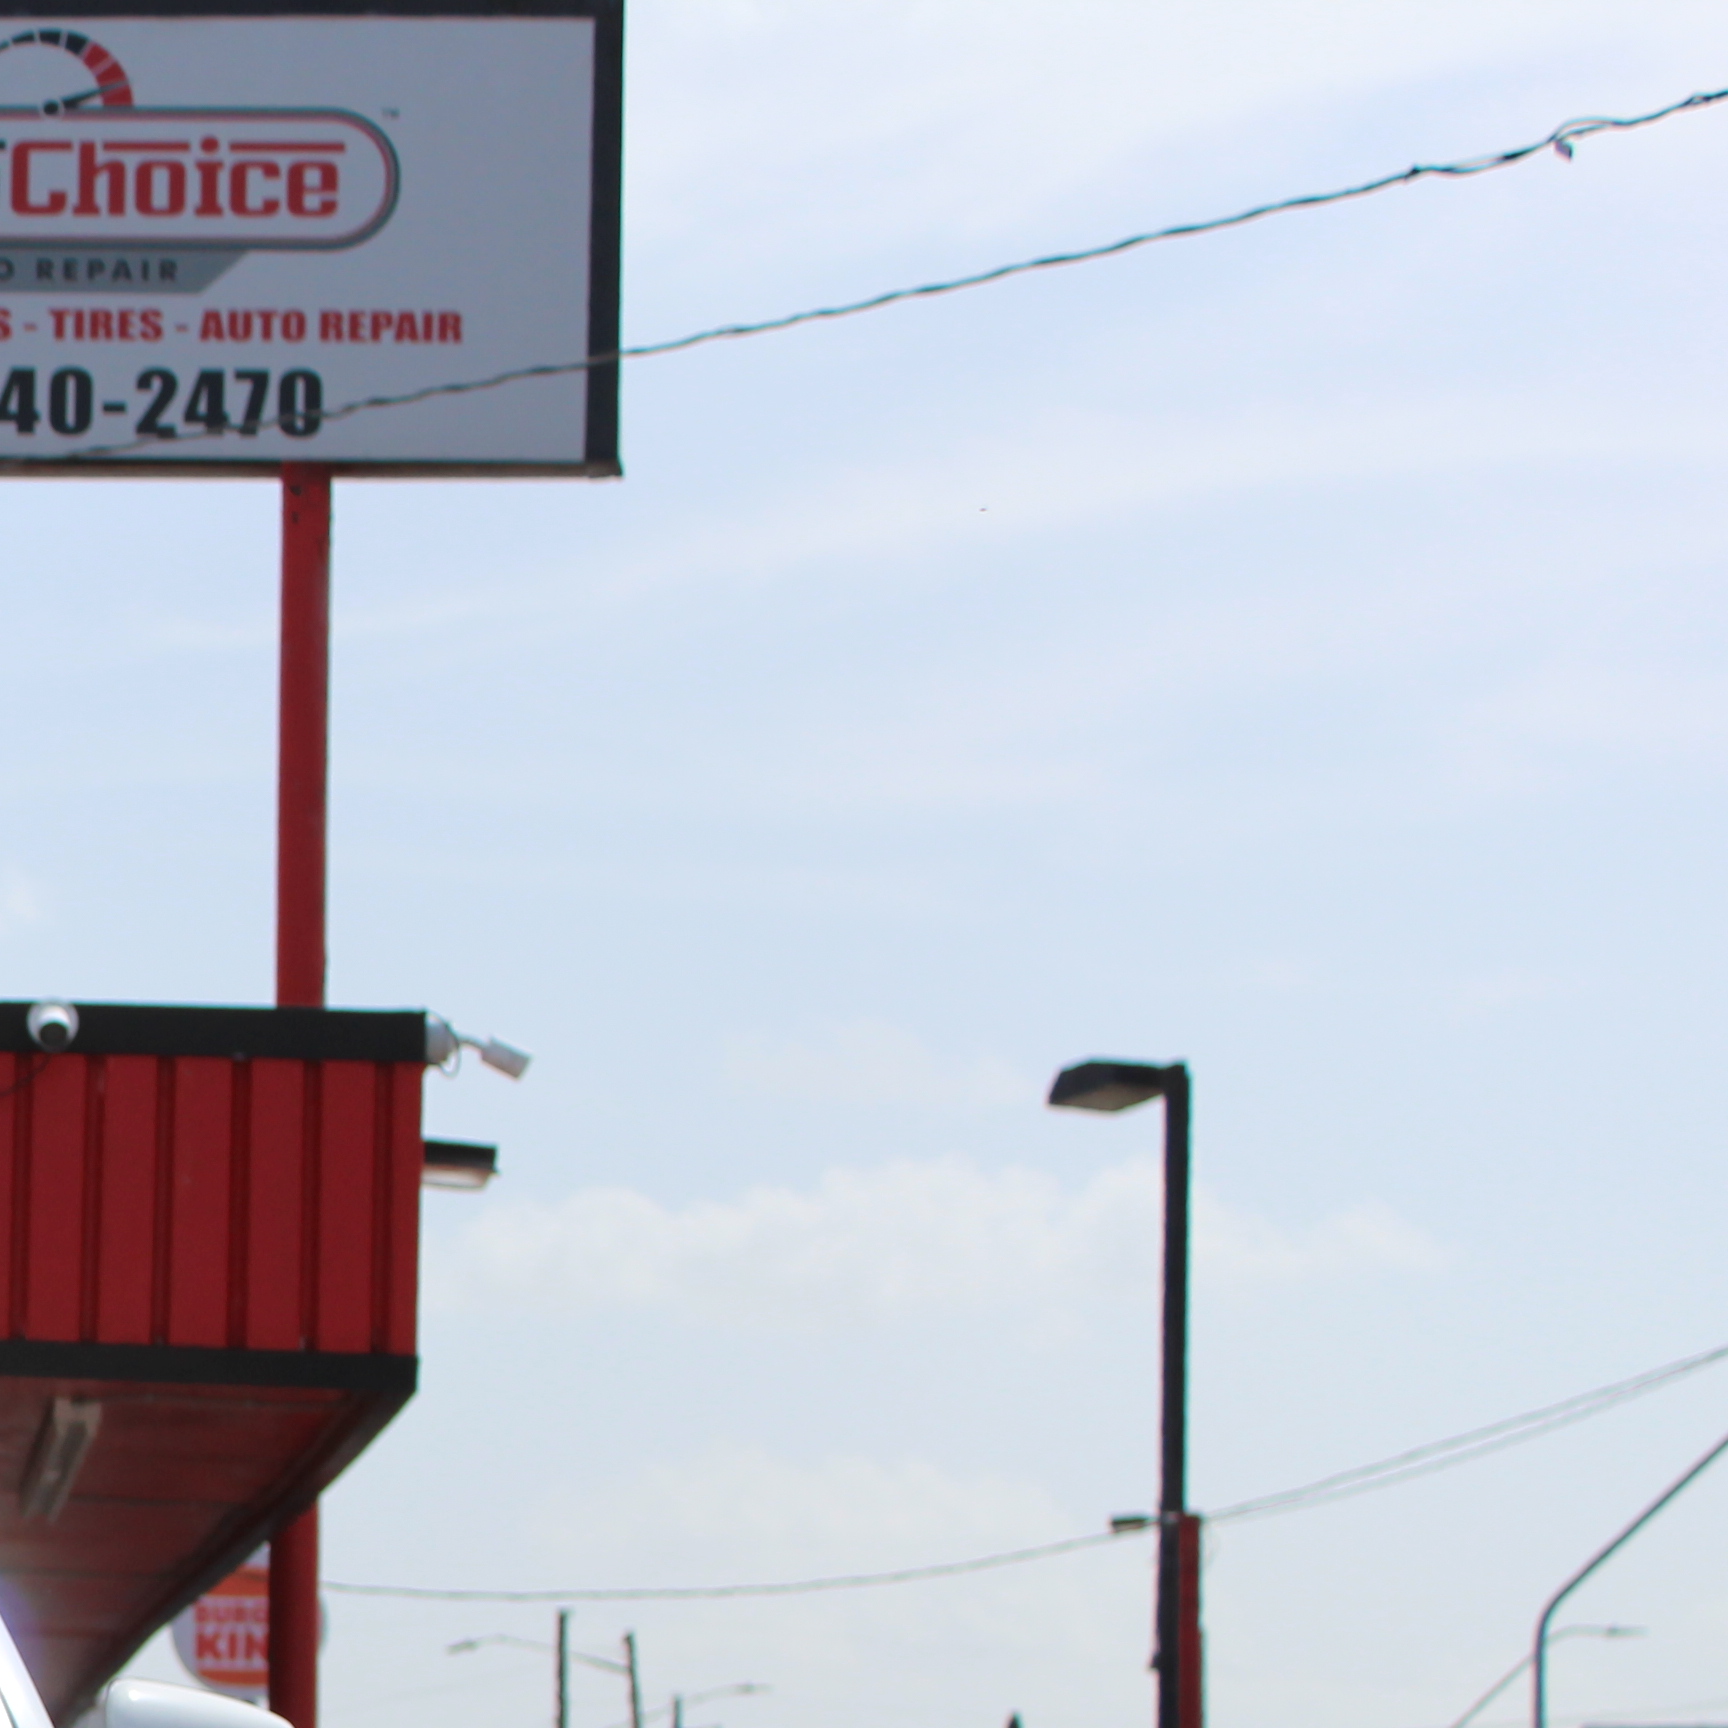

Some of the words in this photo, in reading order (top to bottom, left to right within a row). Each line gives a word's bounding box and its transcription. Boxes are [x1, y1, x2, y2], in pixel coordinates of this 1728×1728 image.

[36, 257, 179, 283] REPAIR
[48, 309, 163, 342] TIRES
[199, 310, 306, 343] AUTO
[319, 311, 463, 344] REPAIR
[196, 1606, 269, 1623] BURG
[196, 1632, 269, 1660] KIN
